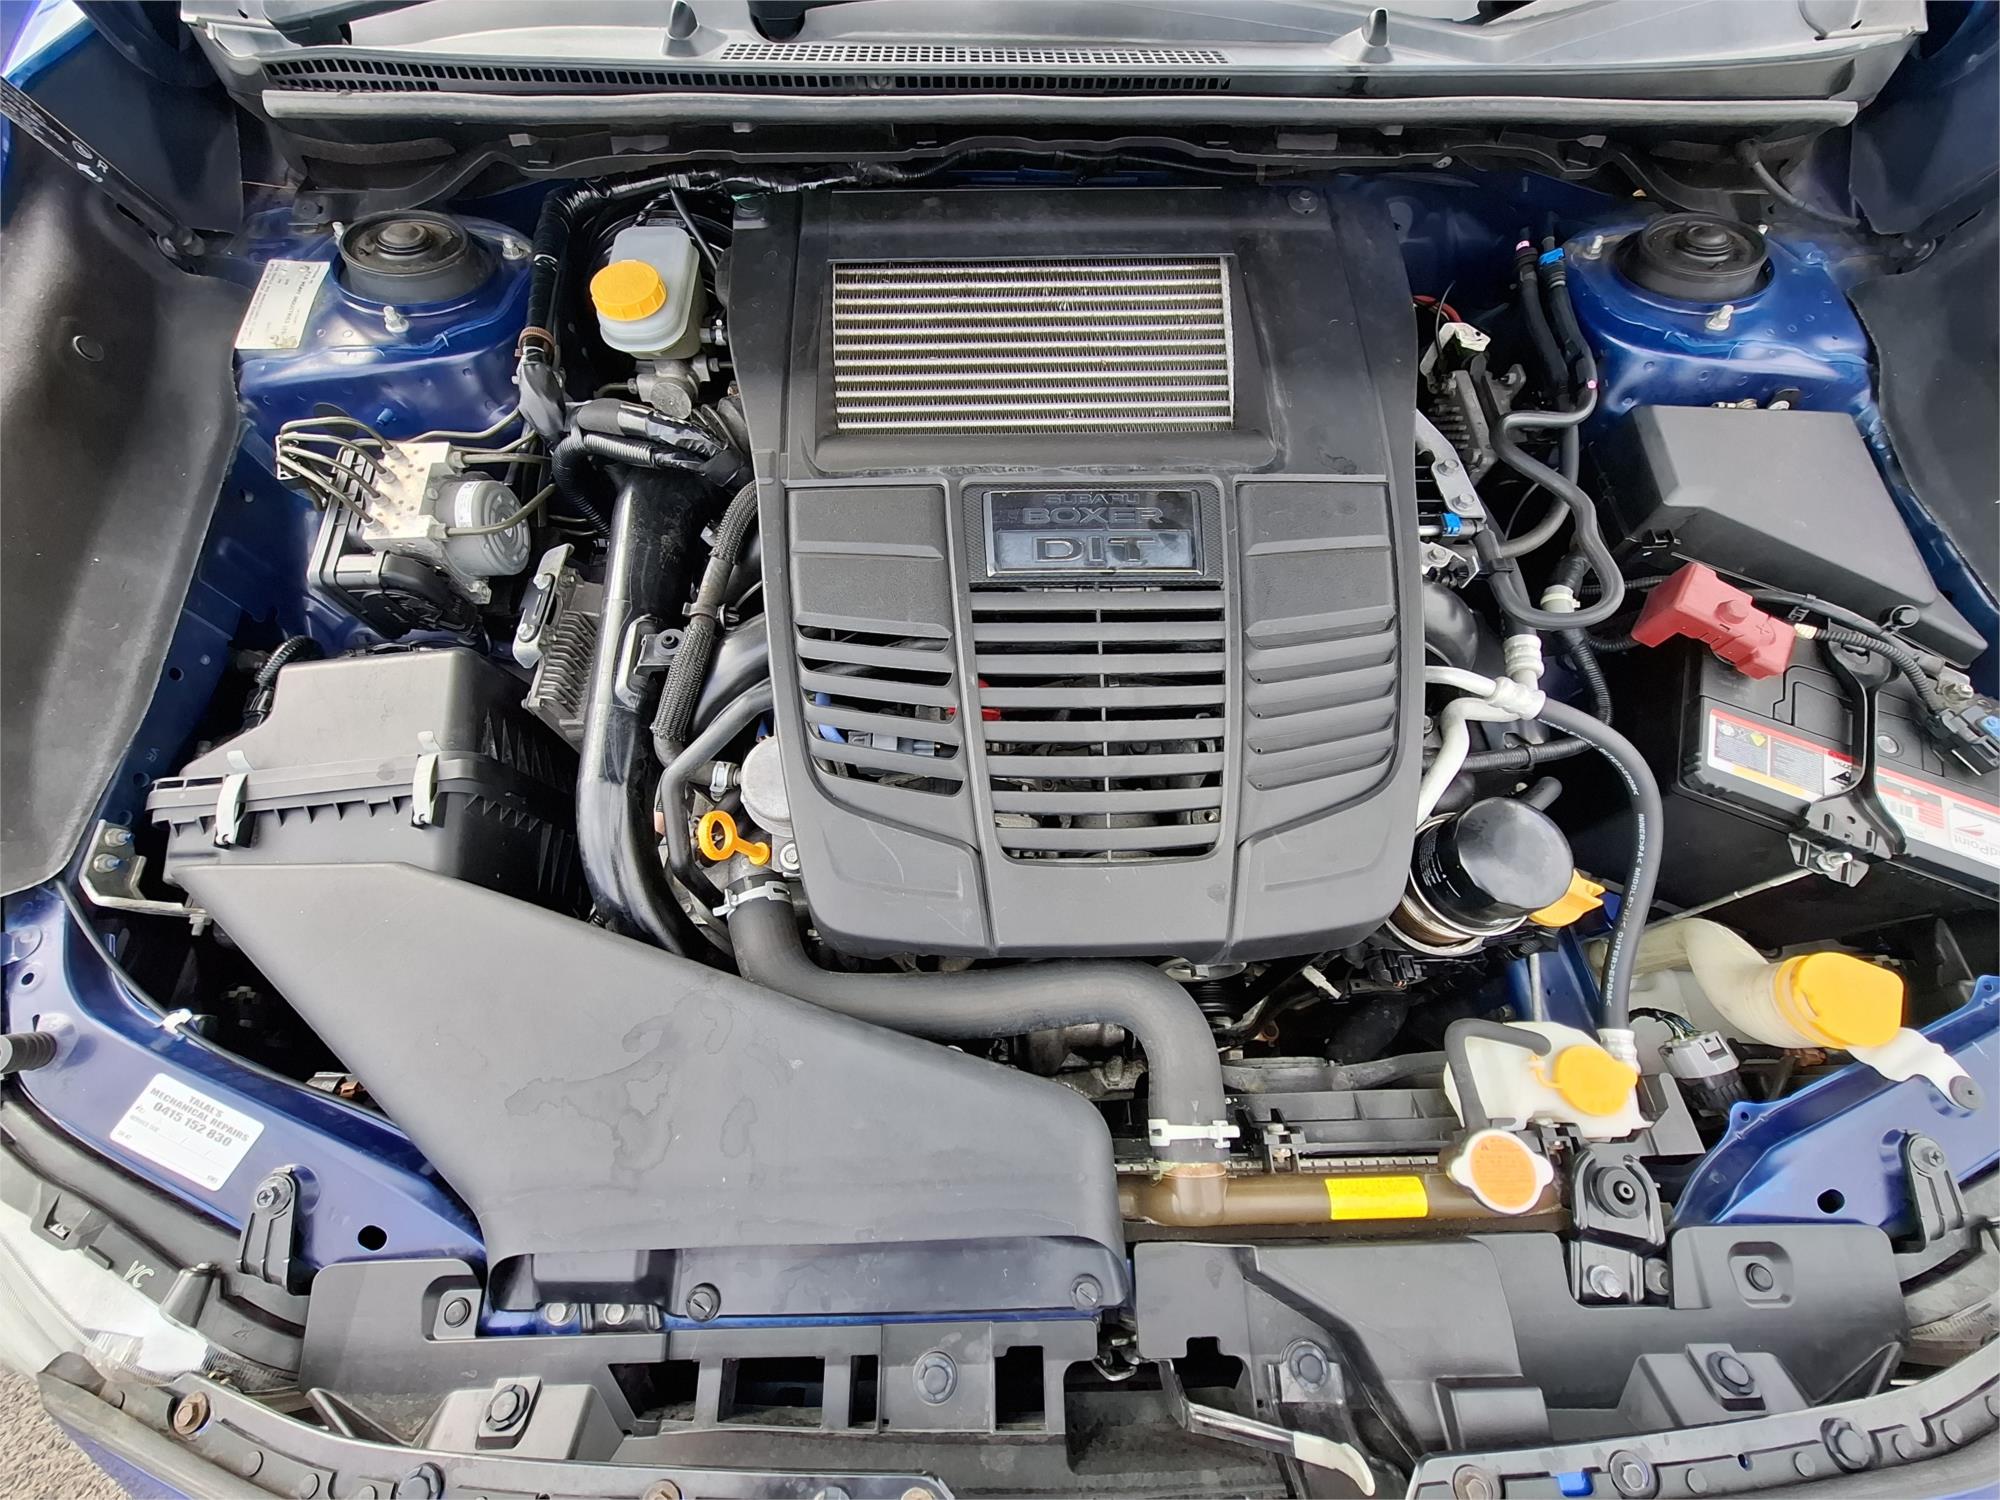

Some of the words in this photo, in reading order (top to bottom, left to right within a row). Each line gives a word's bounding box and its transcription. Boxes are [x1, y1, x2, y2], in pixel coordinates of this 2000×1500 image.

[97, 159, 109, 173] R
[1044, 493, 1140, 505] SUBARU
[1022, 507, 1165, 524] BOXER
[1033, 537, 1157, 563] DIT
[150, 1087, 210, 1122] MECHANICAL
[210, 1117, 250, 1142] REPAIRS
[189, 1095, 225, 1118] TALAL'S
[153, 1101, 183, 1122] 0415
[184, 1116, 207, 1135] 152
[206, 1128, 233, 1147] 830
